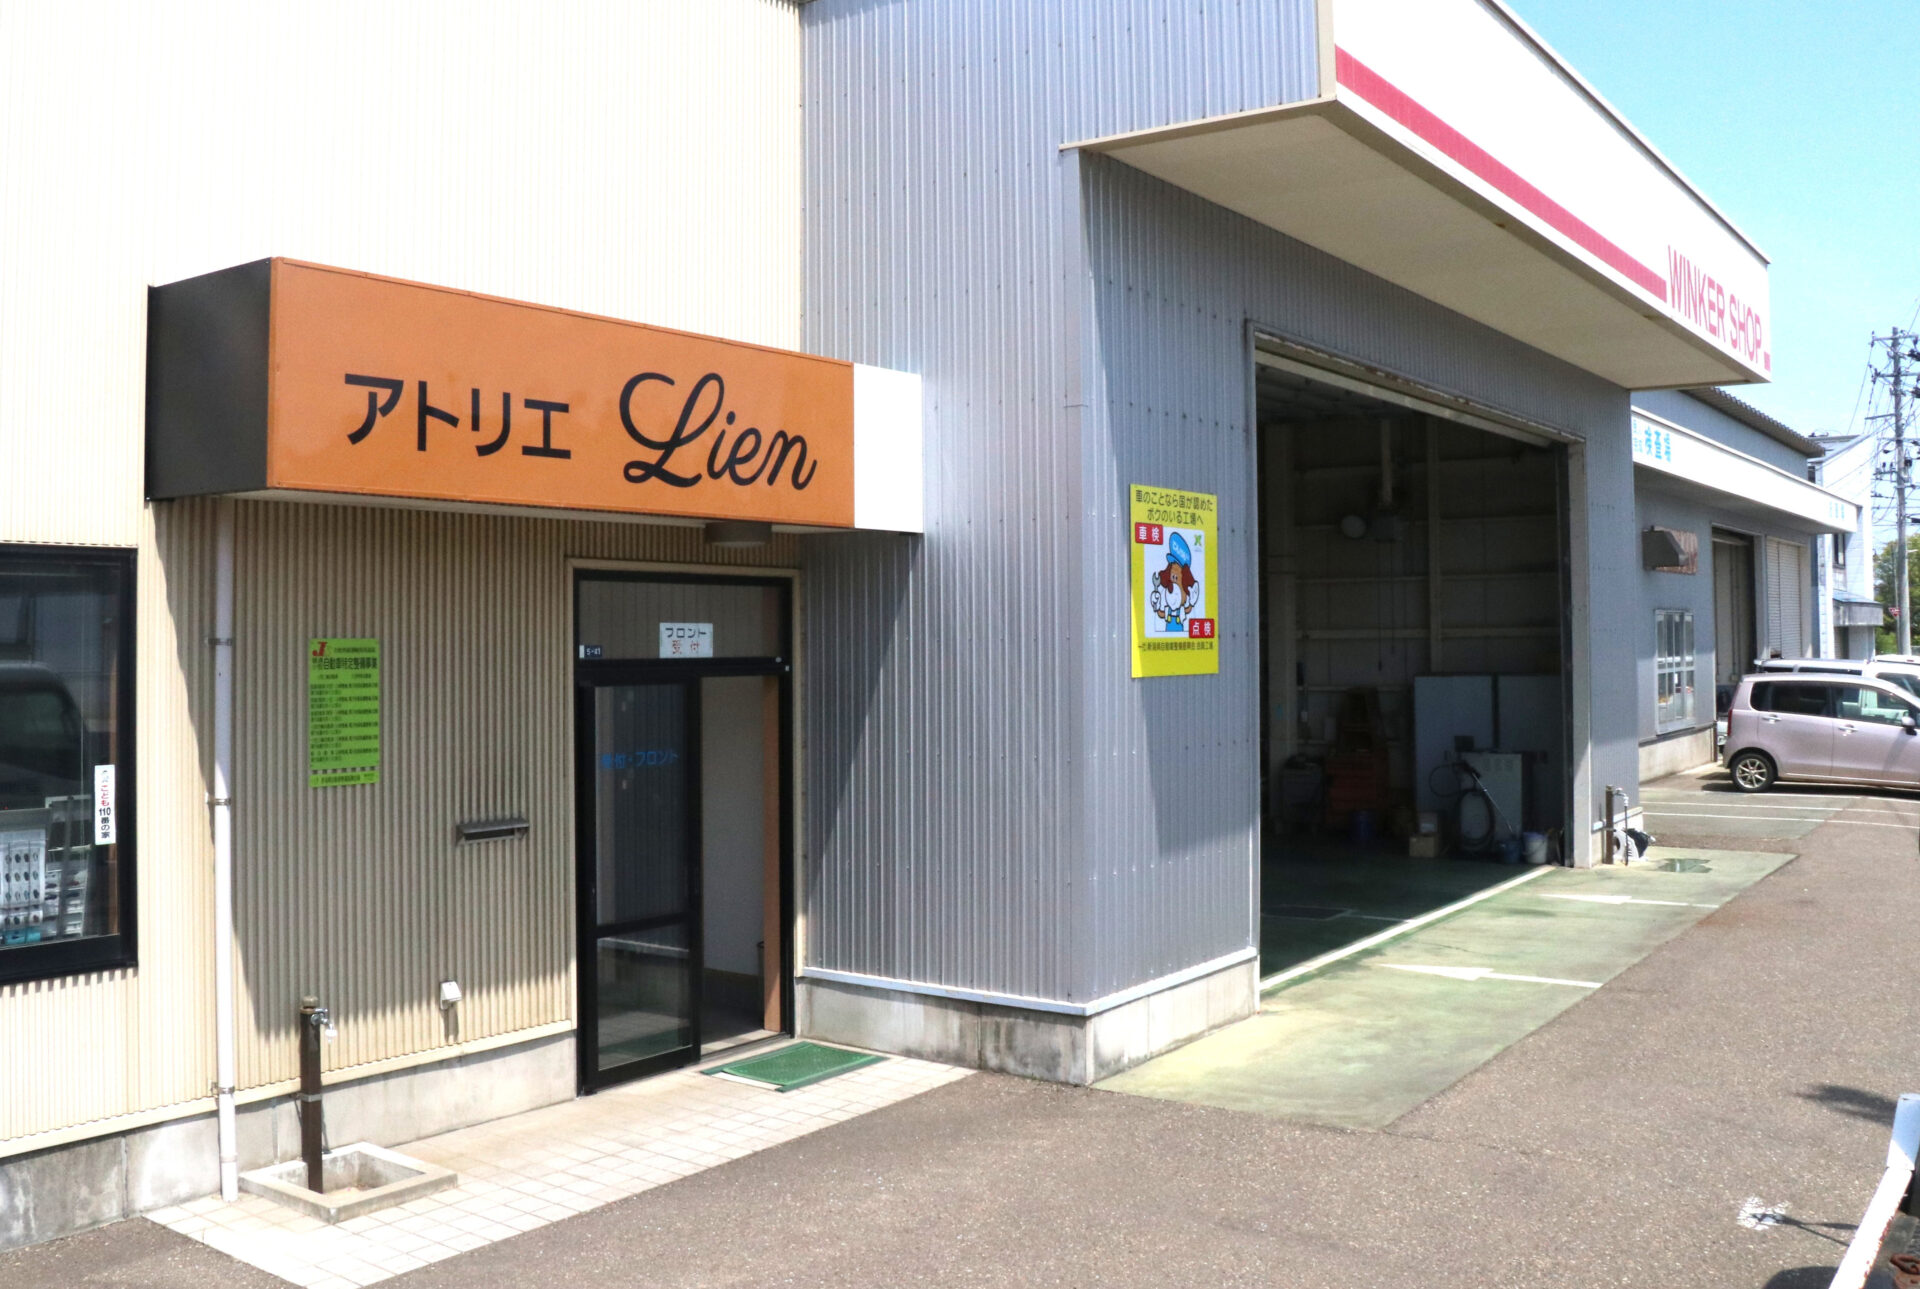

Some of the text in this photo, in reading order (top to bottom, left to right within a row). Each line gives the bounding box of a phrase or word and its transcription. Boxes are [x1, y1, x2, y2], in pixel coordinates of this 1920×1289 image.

[1667, 244, 1763, 364] WINKER SHOP
[344, 372, 818, 491] アトリエ Lien
[1135, 489, 1213, 512] 車のことなら国が認めた
[665, 627, 708, 639] フロント
